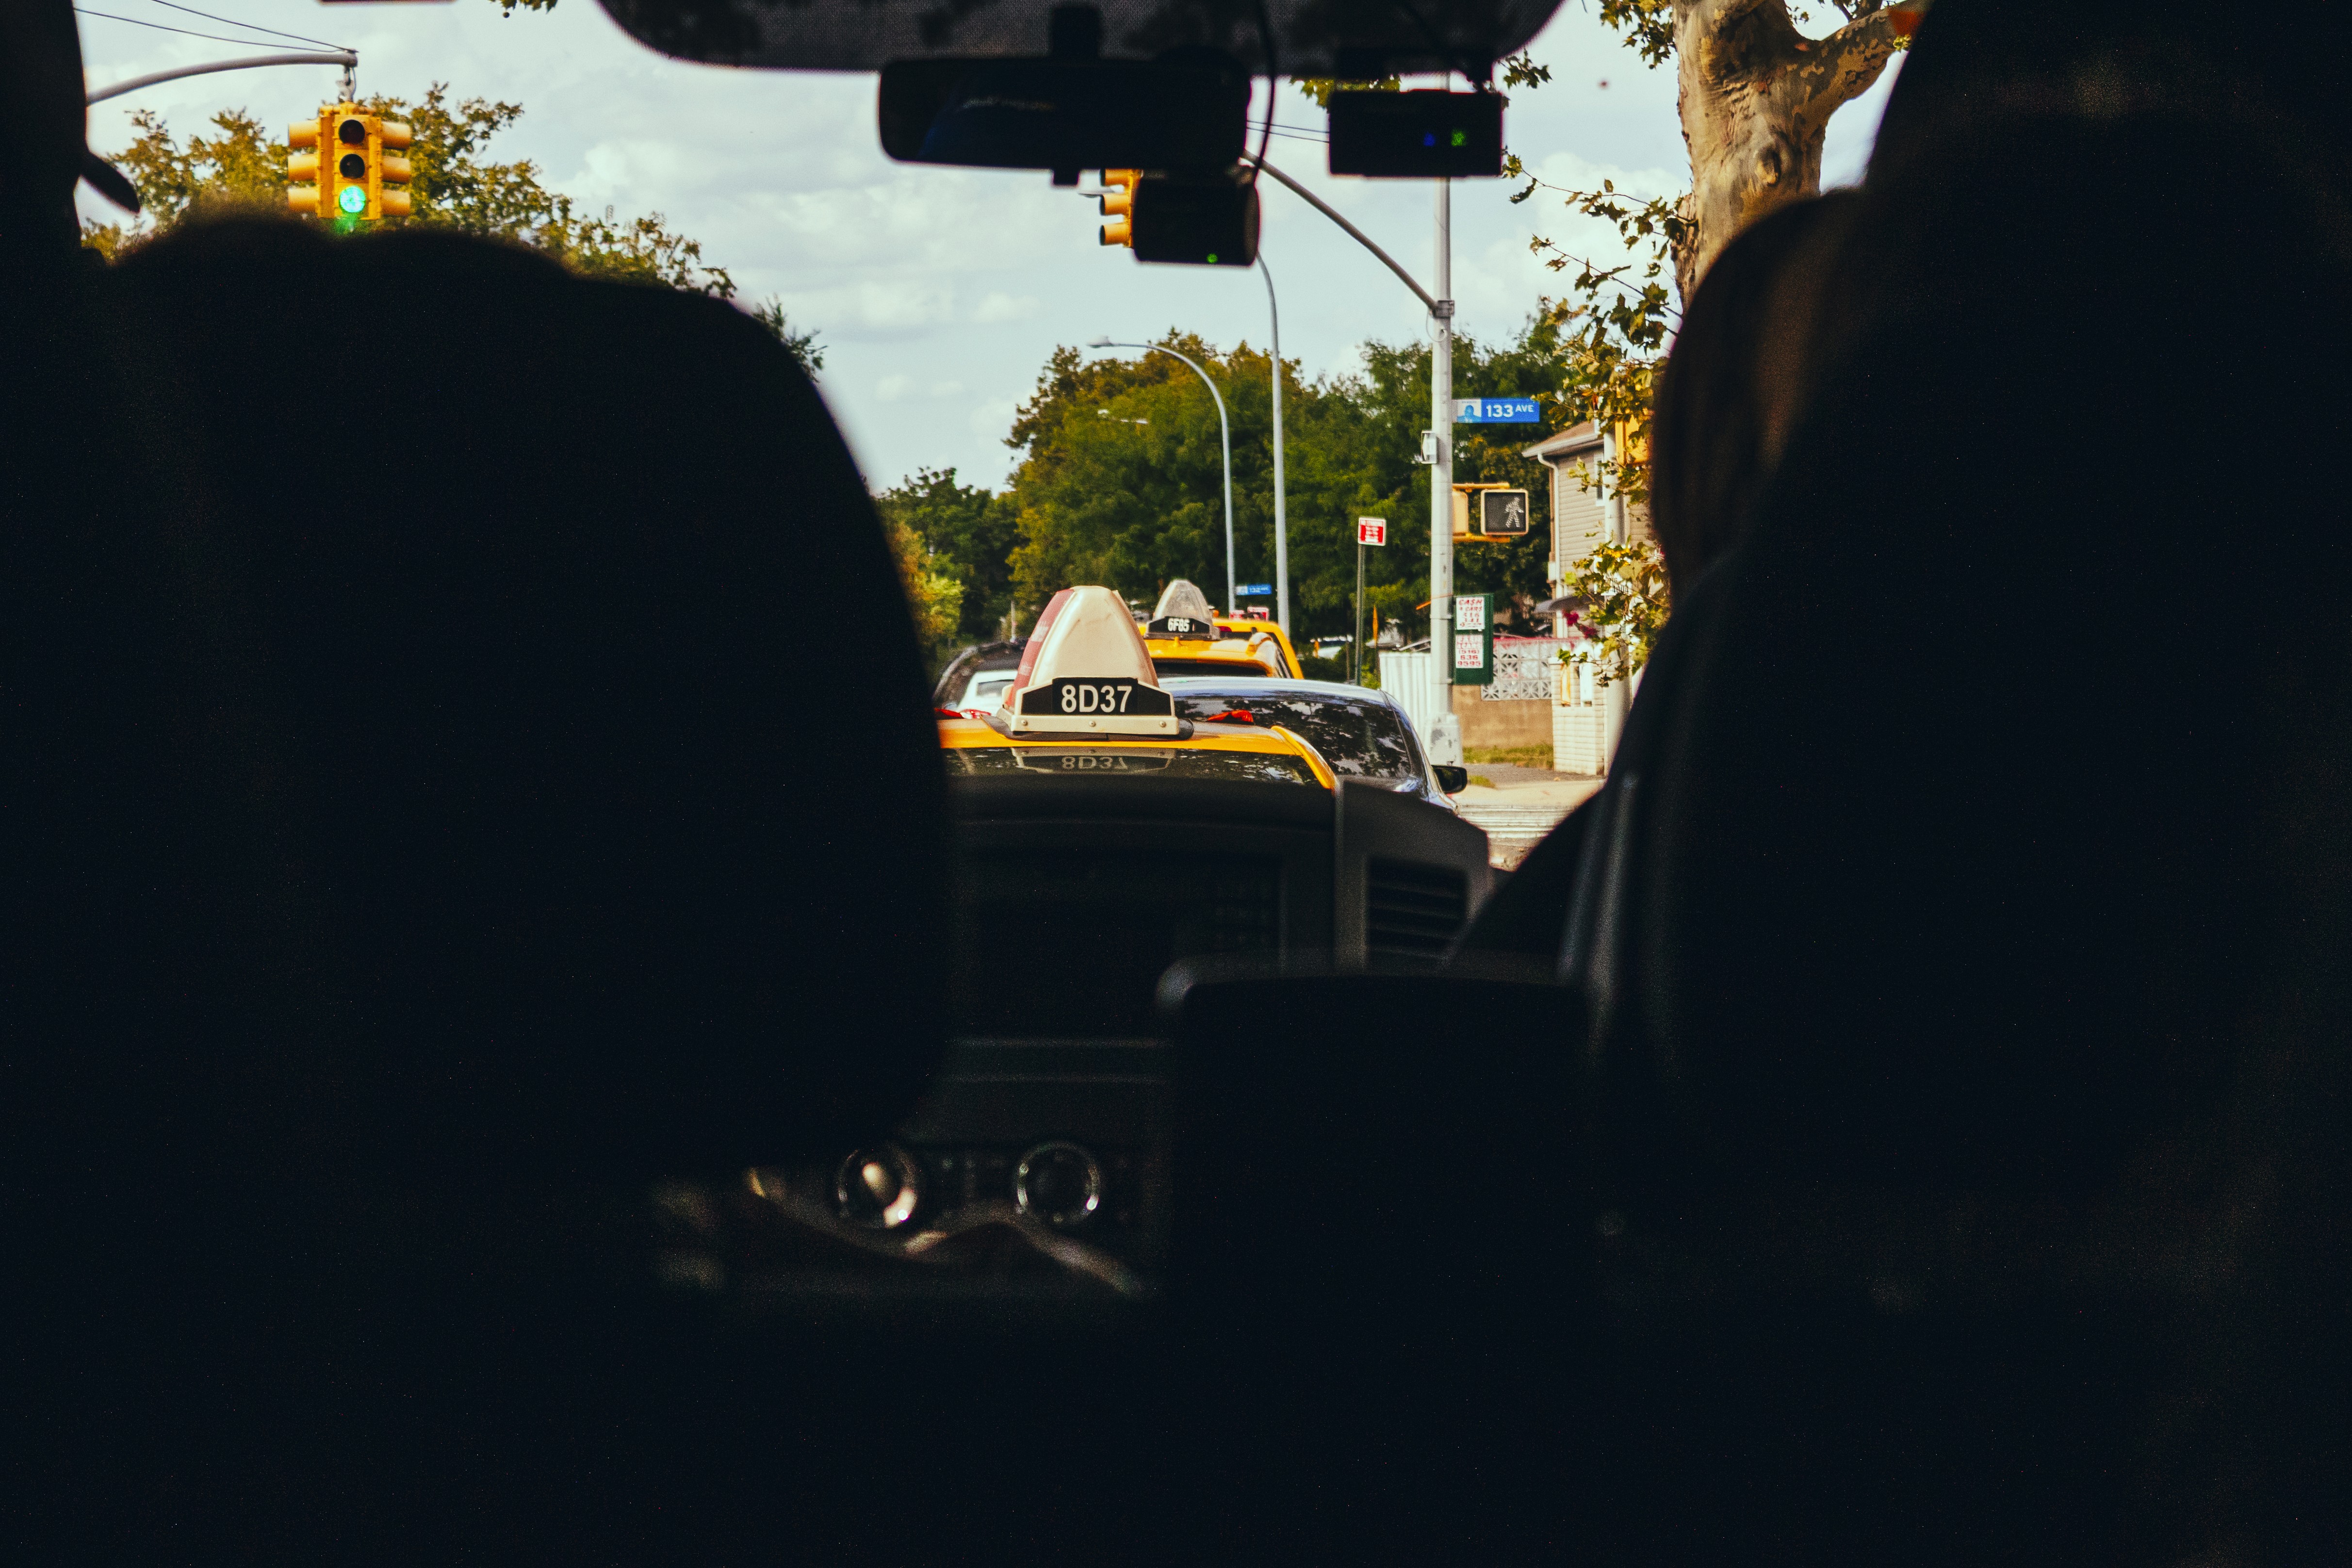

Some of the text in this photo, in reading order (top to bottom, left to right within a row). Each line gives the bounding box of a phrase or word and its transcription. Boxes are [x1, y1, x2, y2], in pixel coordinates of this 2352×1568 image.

[1486, 405, 1514, 418] 133
[1168, 618, 1190, 632] 6F85
[1061, 685, 1132, 713] 8D37
